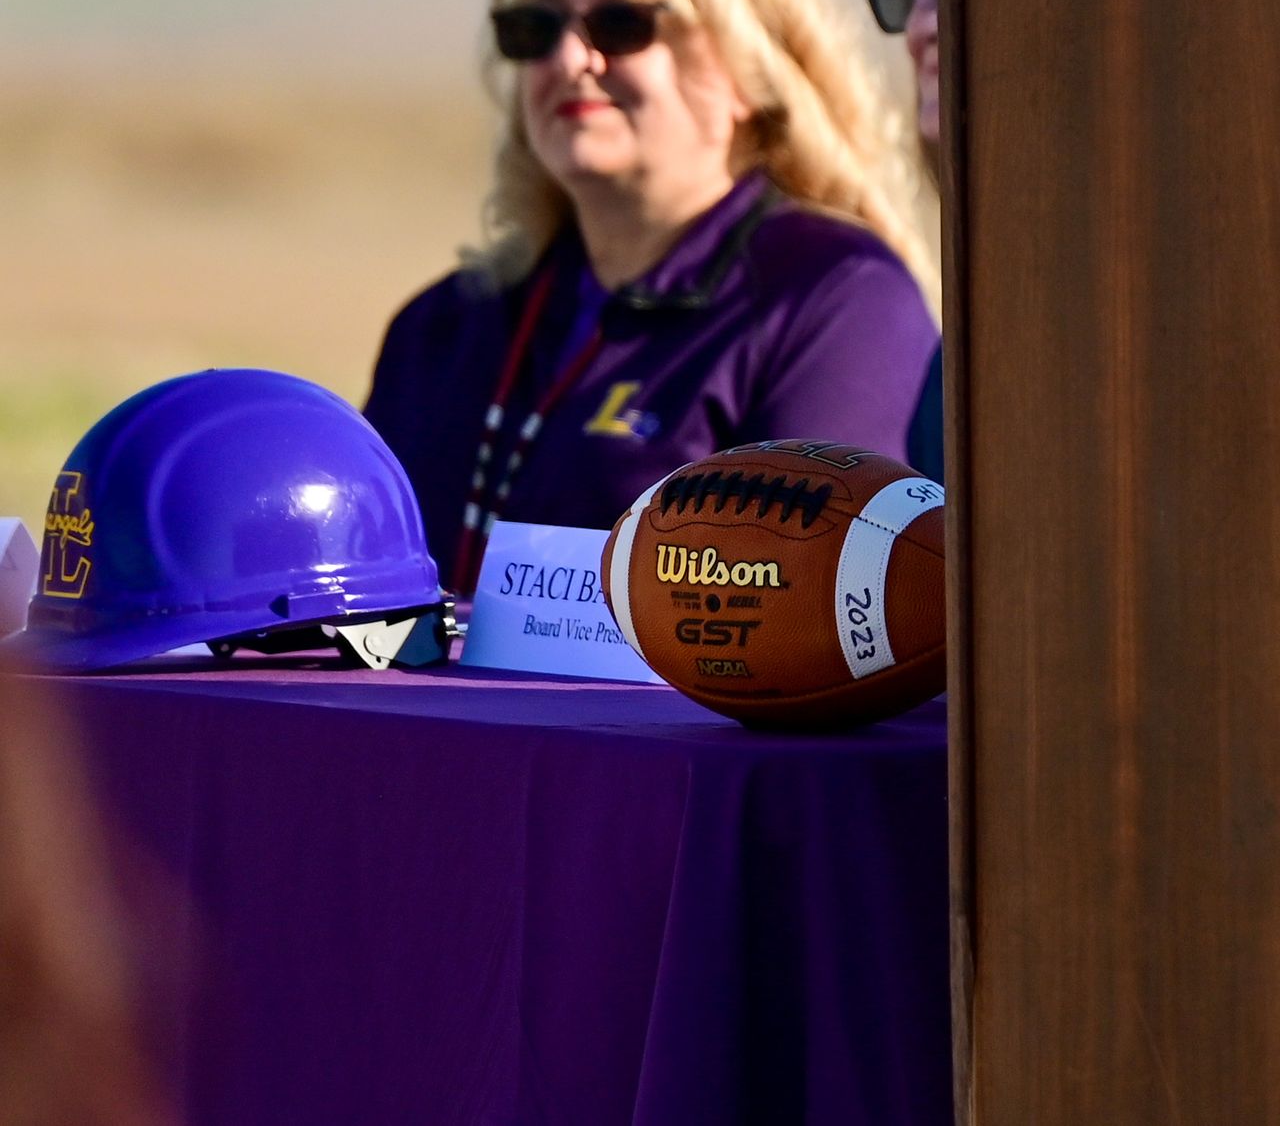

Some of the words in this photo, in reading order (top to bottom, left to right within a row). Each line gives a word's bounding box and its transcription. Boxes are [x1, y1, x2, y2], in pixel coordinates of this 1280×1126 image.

[582, 380, 641, 438] L
[46, 508, 95, 550] engals
[500, 561, 575, 601] STACI
[656, 544, 781, 587] Wilson
[523, 614, 563, 639] Board
[566, 618, 593, 642] Vice
[594, 621, 630, 646] Presi
[675, 617, 763, 647] GST
[845, 587, 876, 661] 2023
[696, 658, 751, 676] NCAA
